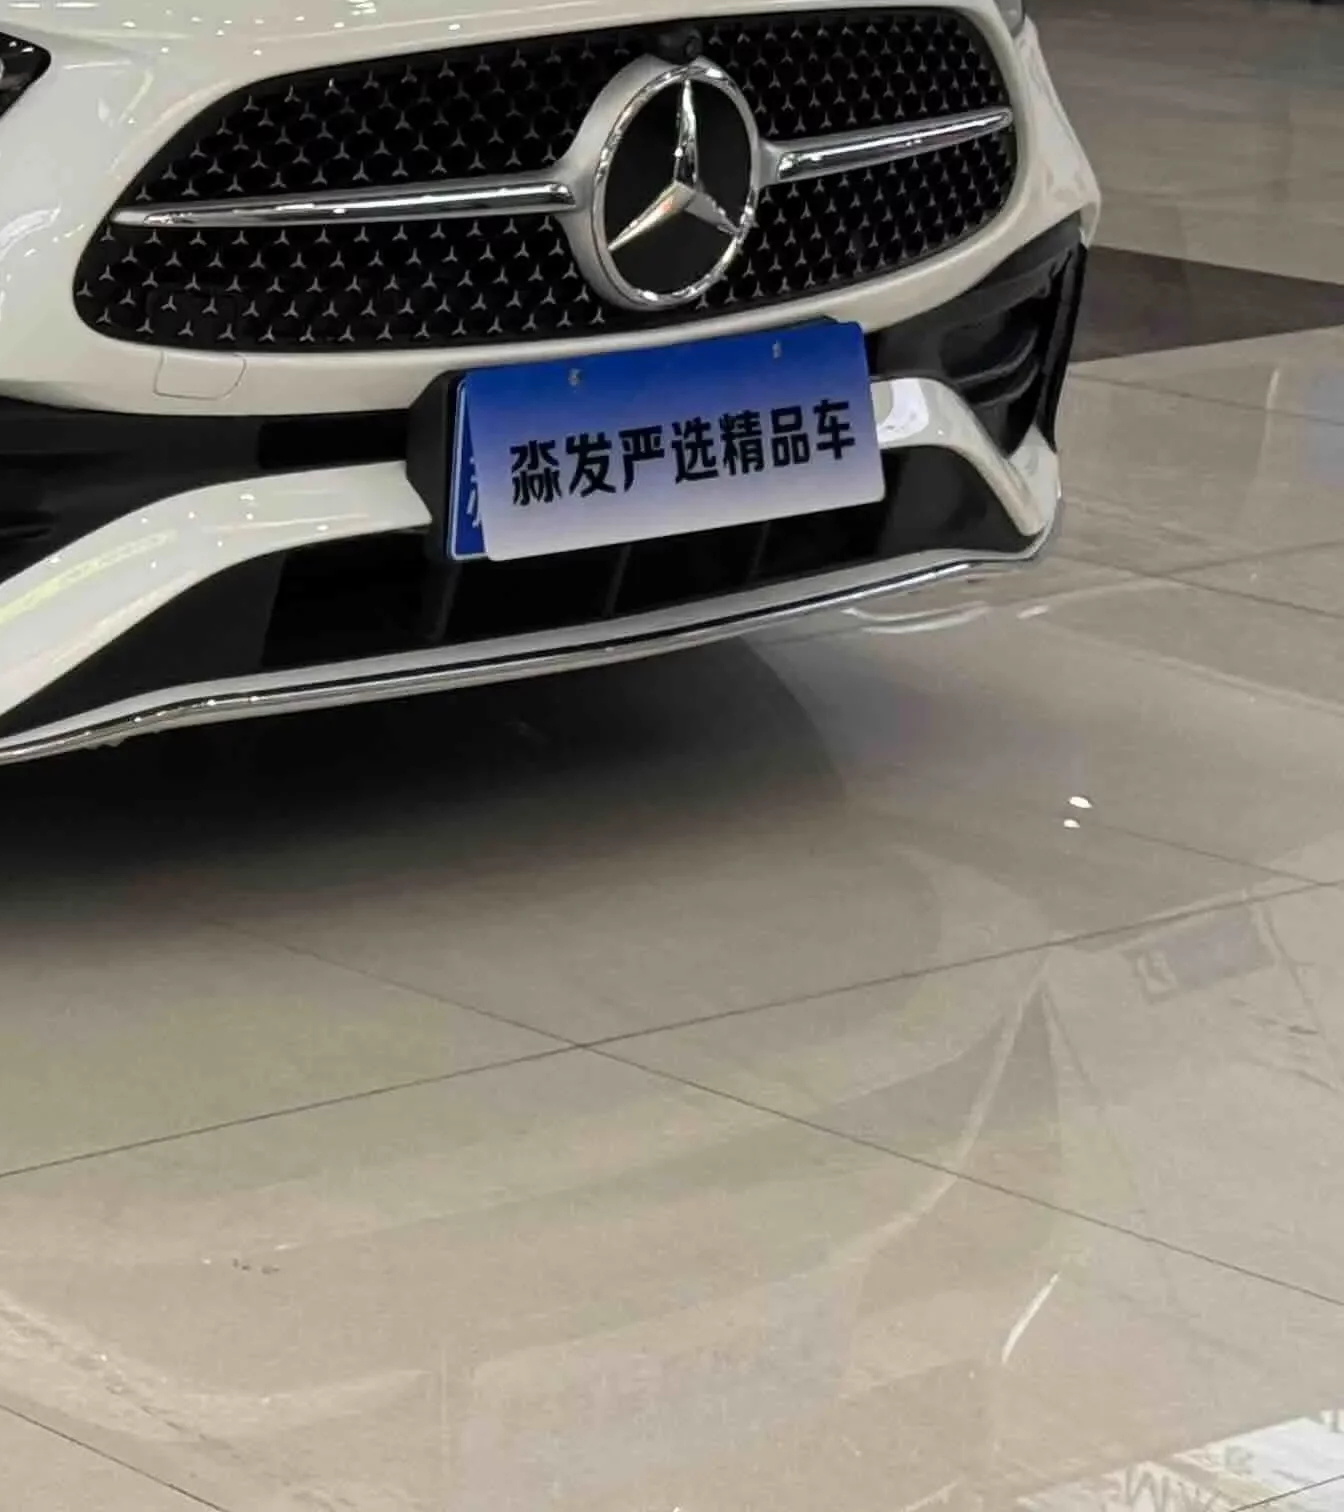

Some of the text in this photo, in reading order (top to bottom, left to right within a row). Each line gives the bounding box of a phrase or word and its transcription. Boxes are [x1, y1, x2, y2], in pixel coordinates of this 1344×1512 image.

[509, 398, 856, 507] 淼发严选精品车
